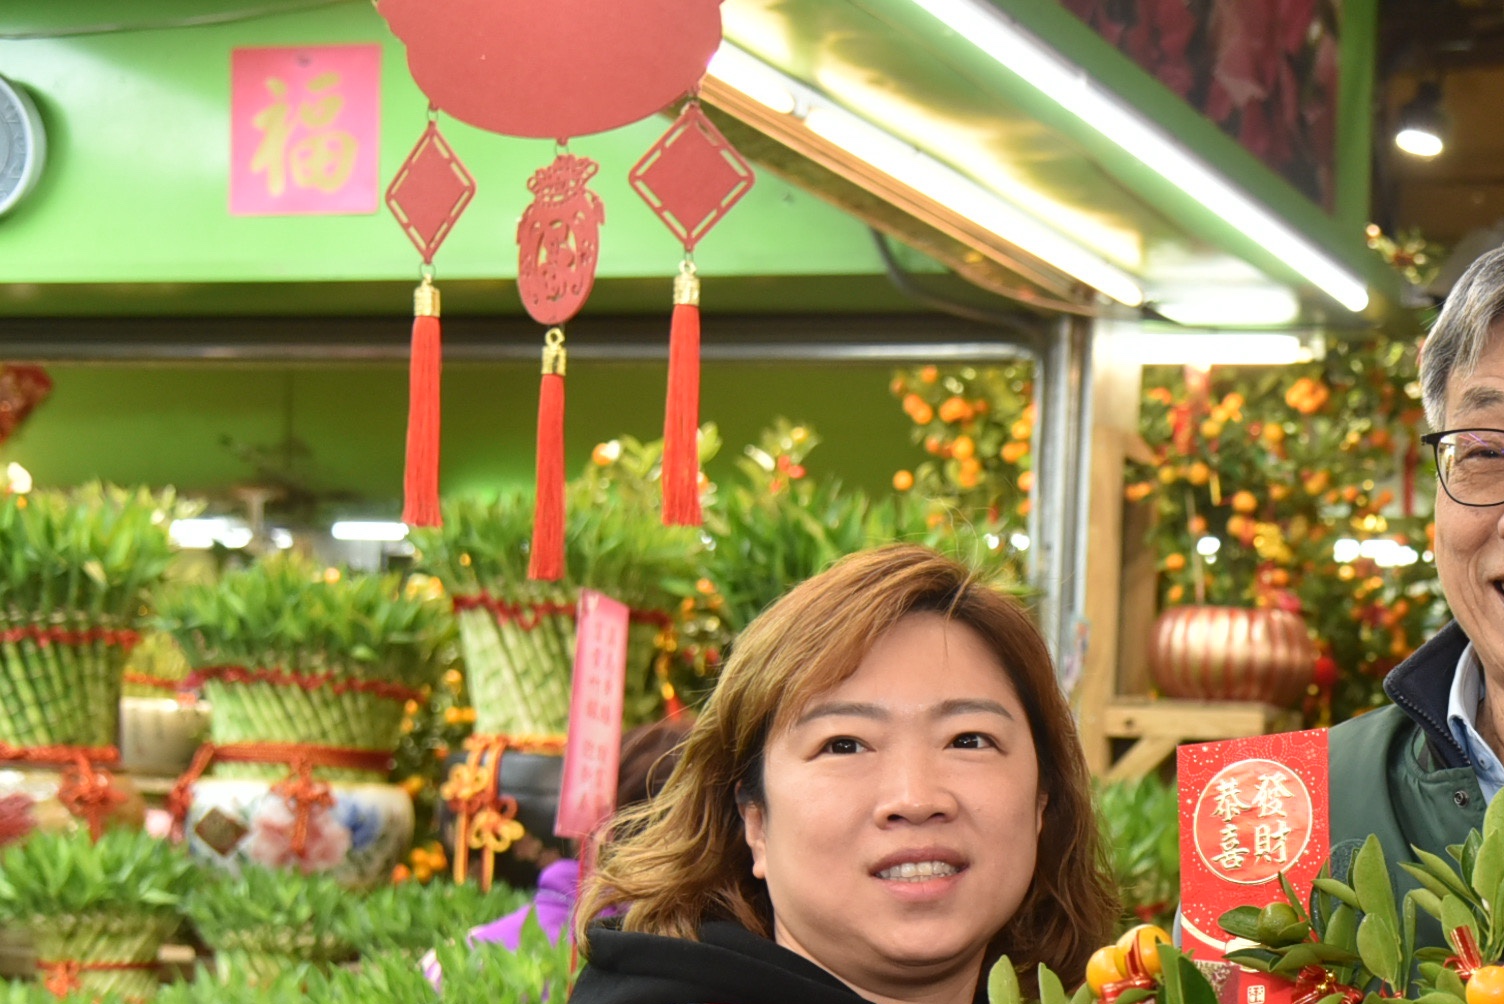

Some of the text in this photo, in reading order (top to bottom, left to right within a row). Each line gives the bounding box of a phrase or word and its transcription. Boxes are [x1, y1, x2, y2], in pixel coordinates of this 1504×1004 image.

[250, 71, 359, 197] 福
[1210, 776, 1251, 871] 恭喜
[1251, 771, 1295, 865] 發財
